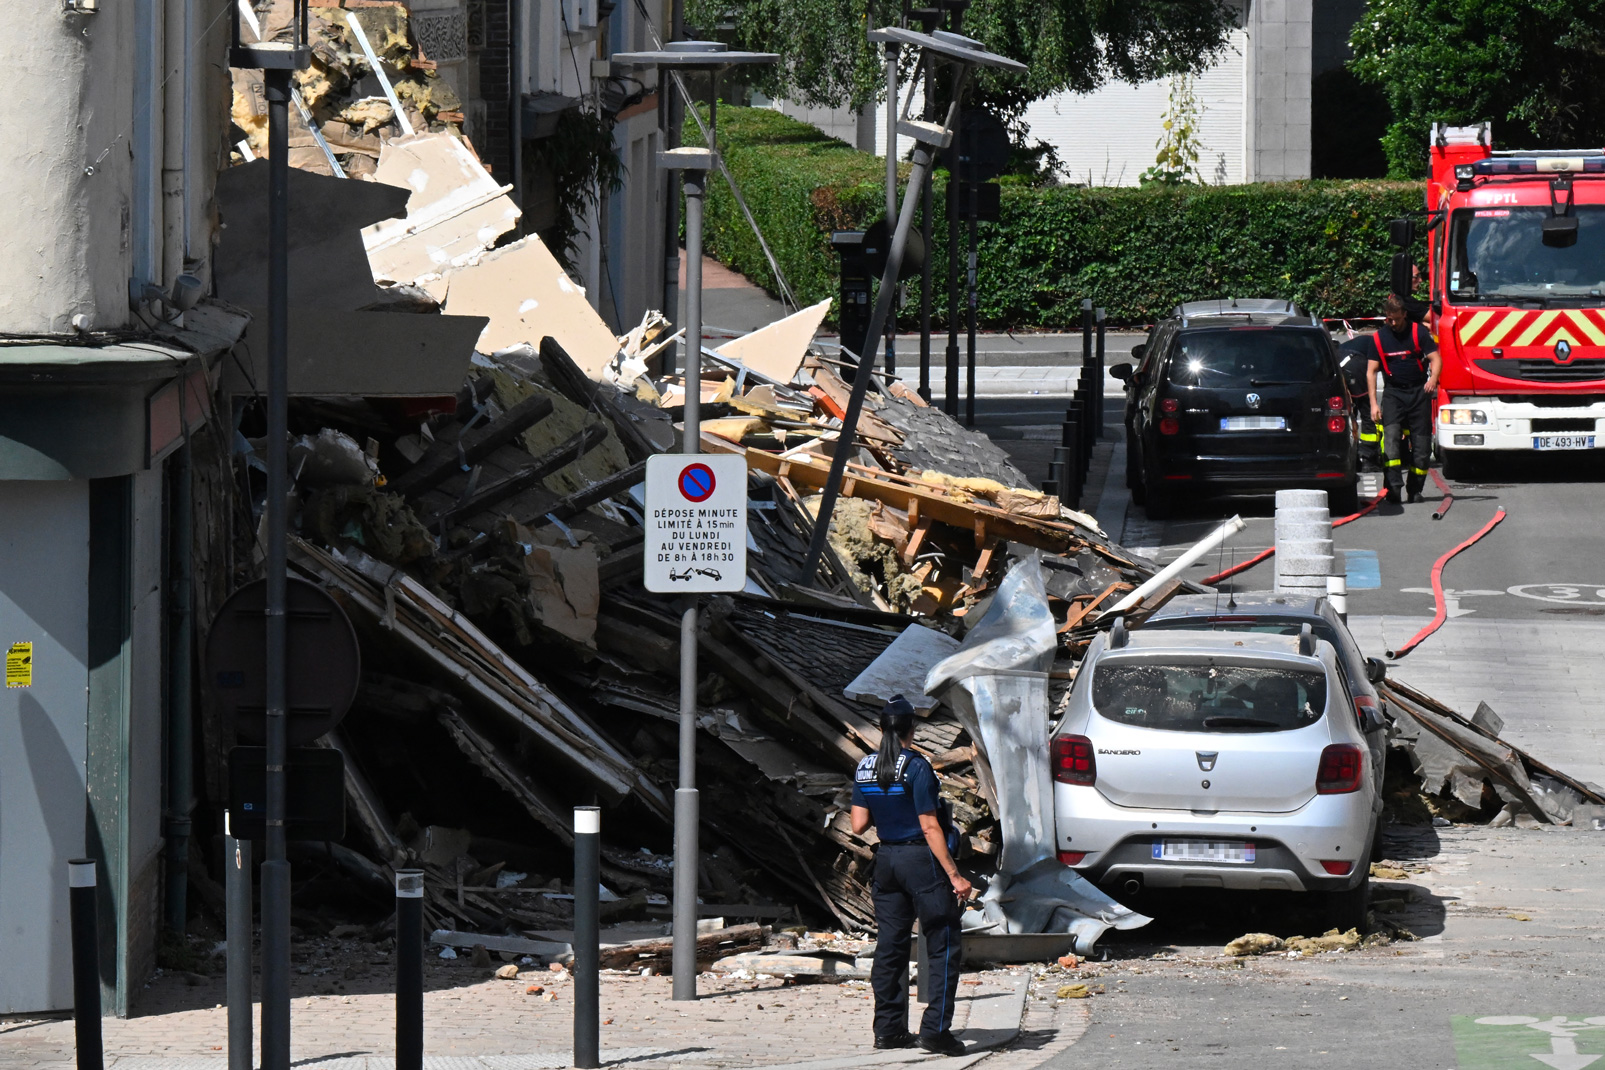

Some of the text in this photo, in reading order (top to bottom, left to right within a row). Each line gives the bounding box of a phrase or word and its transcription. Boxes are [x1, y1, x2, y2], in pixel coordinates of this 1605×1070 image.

[1540, 437, 1587, 448] DE-493-HV
[654, 508, 738, 518] DÉPOSE MINUTE
[657, 519, 692, 529] LIMITÉ
[696, 519, 702, 529] À
[672, 531, 720, 540] DU LUNDI
[661, 542, 731, 551] AU VENDREDI
[657, 553, 670, 562] DE
[674, 553, 687, 562] 8h
[691, 552, 697, 562] À
[1546, 586, 1605, 599] 3
[1097, 748, 1141, 756] SANDERO
